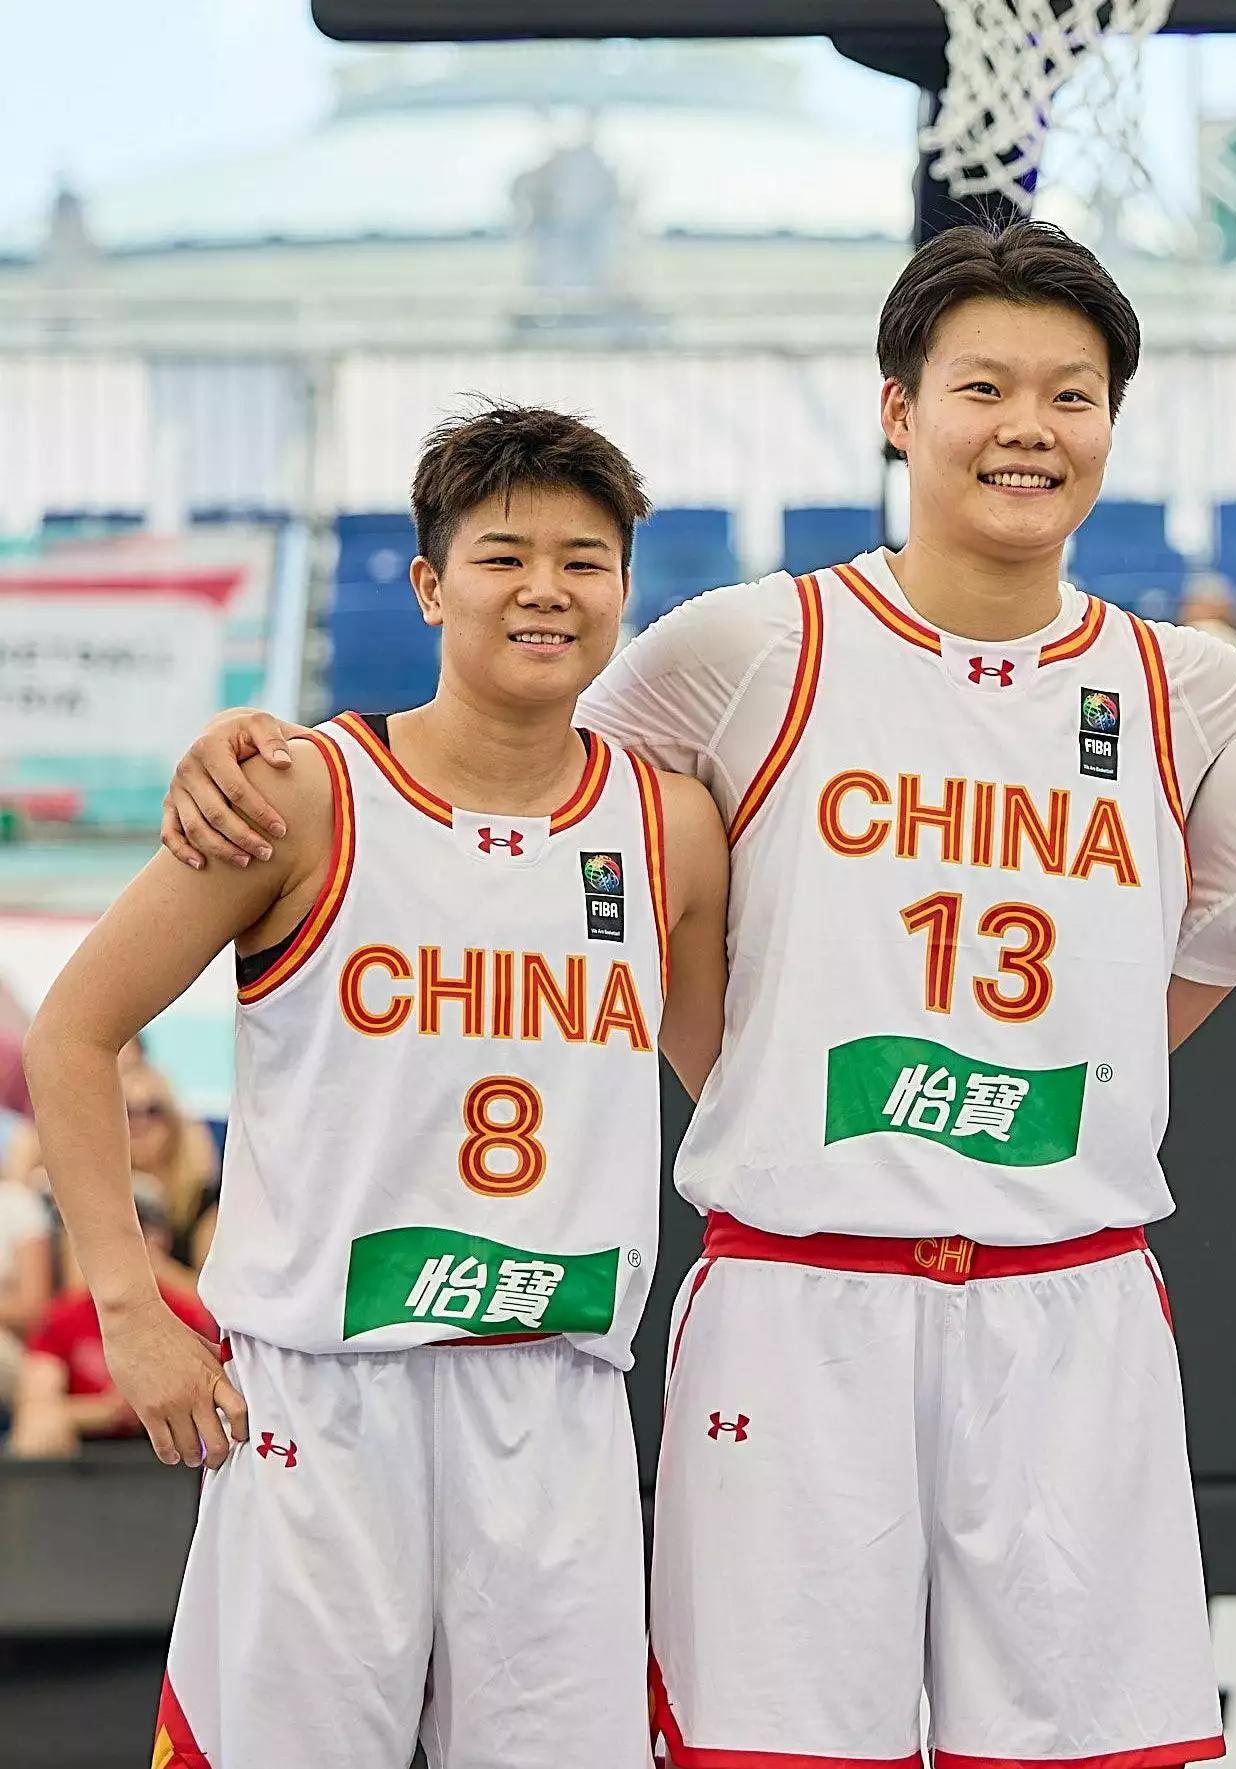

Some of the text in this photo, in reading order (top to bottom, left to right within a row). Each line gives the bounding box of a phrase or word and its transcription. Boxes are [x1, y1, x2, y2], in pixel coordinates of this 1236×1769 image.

[1084, 738, 1112, 757] FIBA
[818, 769, 1140, 887] CHINA
[591, 900, 619, 919] FIBA
[339, 944, 652, 1052] CHINA
[900, 892, 1056, 1023] 13
[458, 1075, 547, 1197] 8
[881, 1063, 1031, 1142] 怡寶
[403, 1254, 565, 1329] 怡寶
